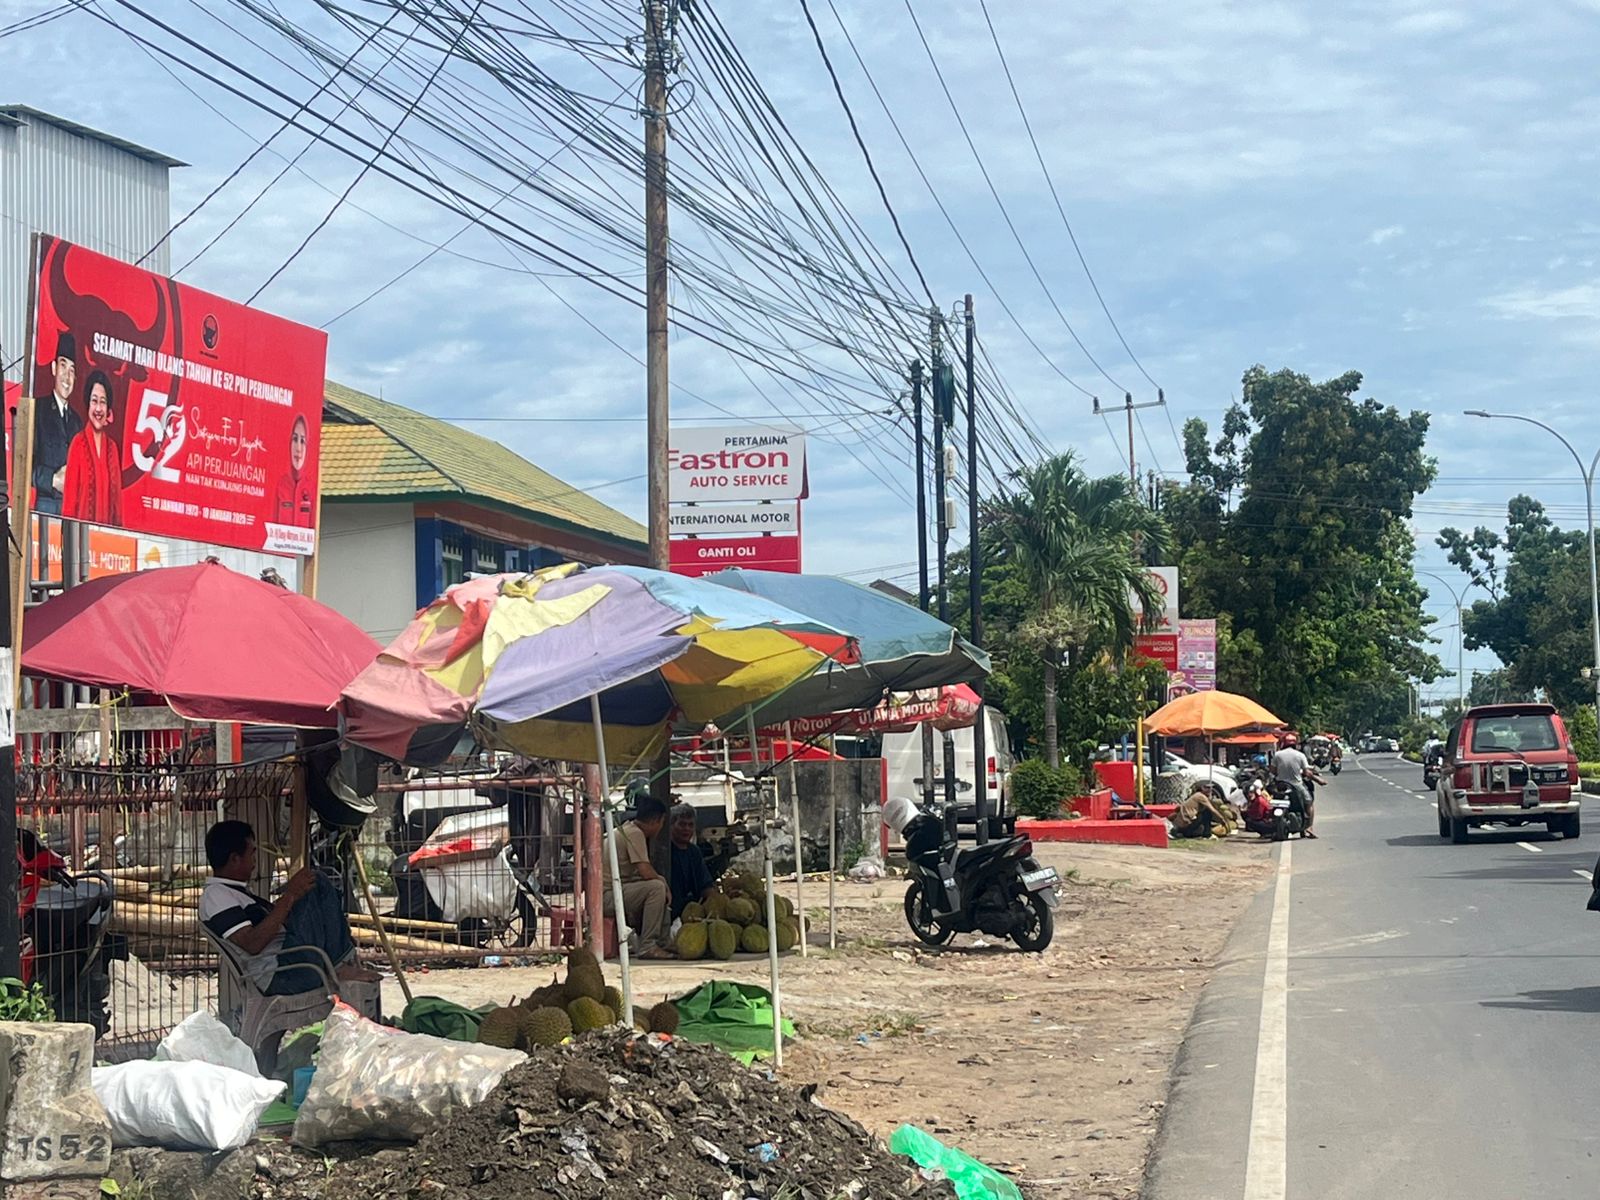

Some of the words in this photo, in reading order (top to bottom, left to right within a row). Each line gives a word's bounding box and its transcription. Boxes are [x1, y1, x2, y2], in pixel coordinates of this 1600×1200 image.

[93, 332, 134, 362] SELAMAT
[134, 345, 156, 369] HARI
[157, 351, 184, 377] ULANG
[186, 360, 212, 385] TAHUN
[212, 368, 223, 388] KE
[223, 372, 234, 391] 52
[235, 375, 248, 396] PDI
[249, 379, 293, 407] PERJUANGAN
[725, 435, 788, 446] PERTAMINA
[186, 453, 203, 470] API
[204, 455, 266, 483] PERJUANGAN
[690, 476, 728, 487] AUTO
[733, 474, 788, 486] SERVICE
[242, 484, 265, 497] PADAM
[160, 499, 184, 514] JANUARI
[668, 514, 748, 525] NTERNATIONAL
[751, 513, 790, 523] MOTOR
[698, 547, 734, 557] GANTI
[737, 547, 756, 556] OLI
[100, 551, 131, 572] MOTOR
